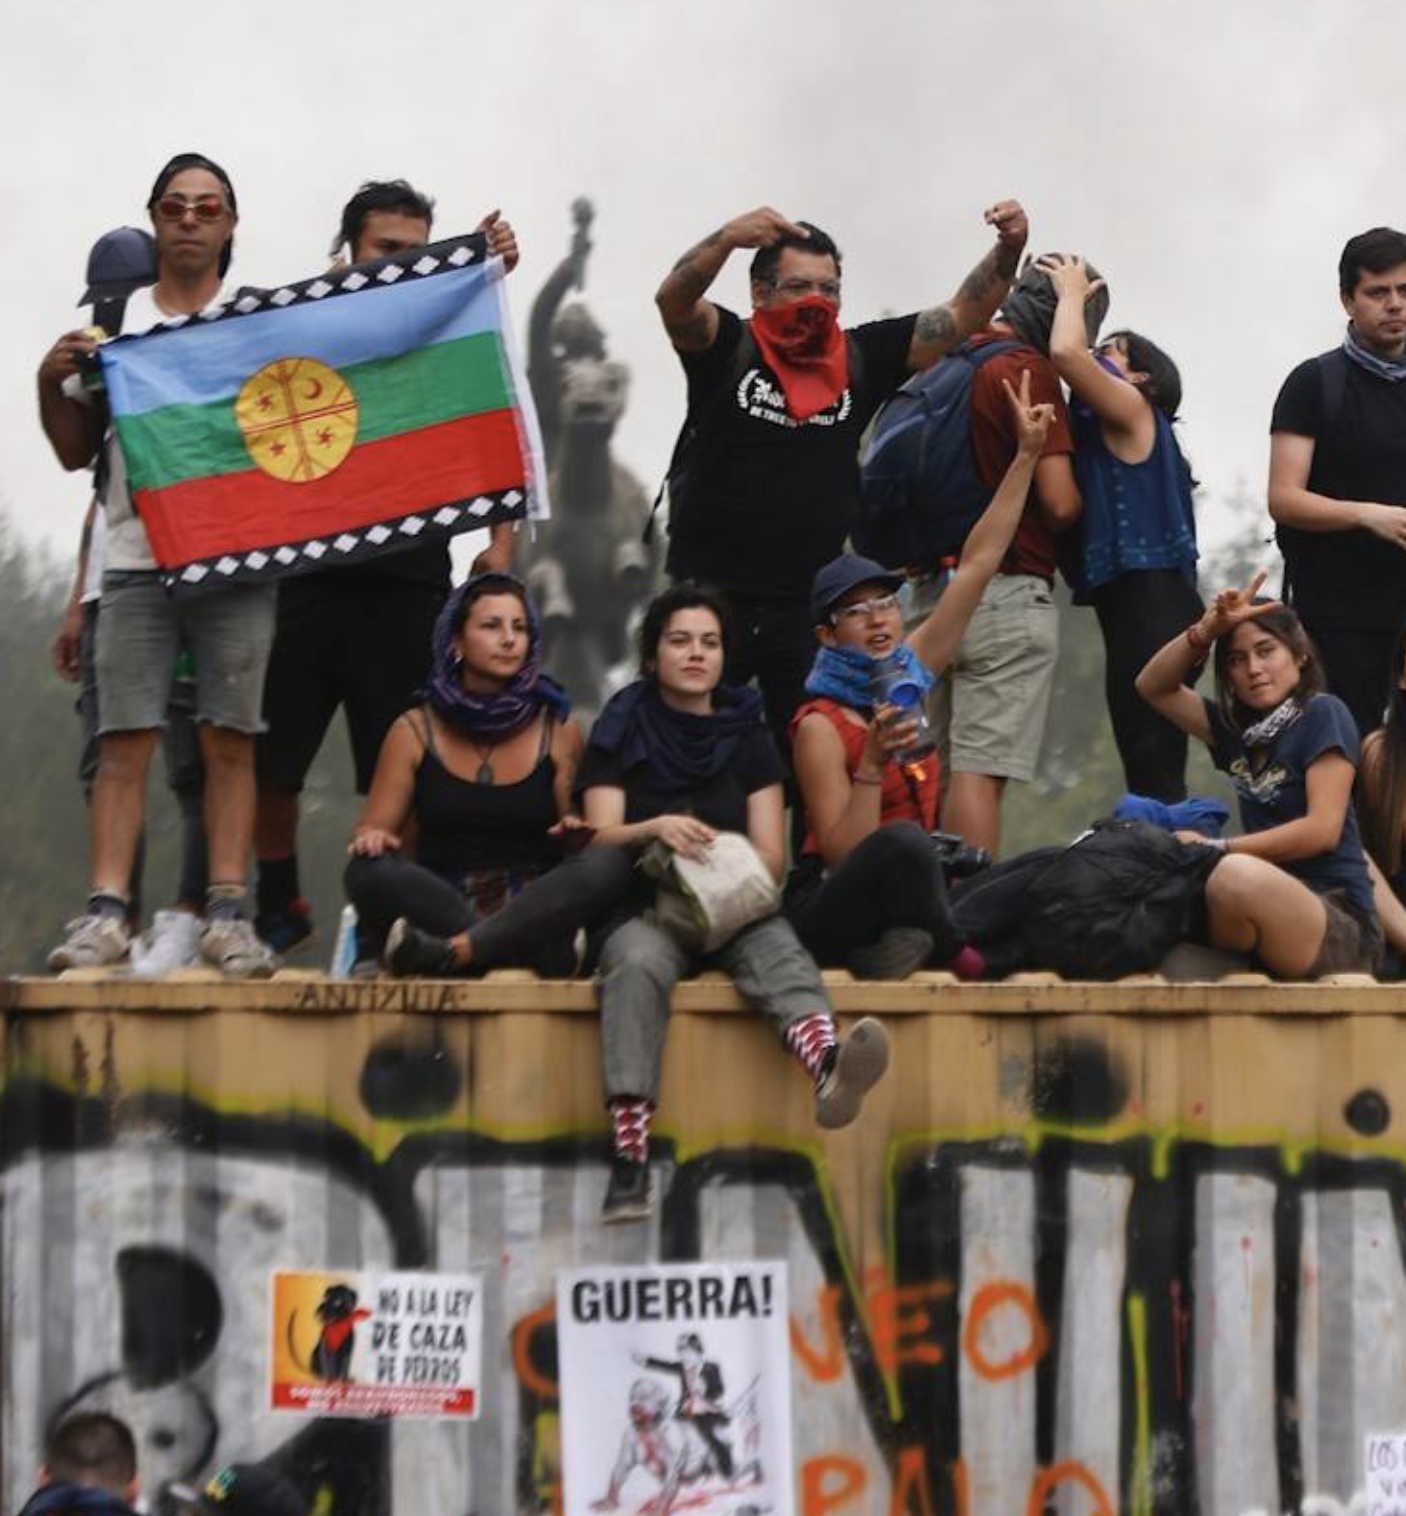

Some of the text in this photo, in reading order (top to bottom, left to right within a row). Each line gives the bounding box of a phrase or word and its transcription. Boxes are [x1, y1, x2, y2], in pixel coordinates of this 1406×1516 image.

[378, 1289, 475, 1318] NO A LA LEY
[571, 1275, 774, 1323] GUERRA!
[372, 1323, 468, 1352] DE CAZA
[377, 1356, 461, 1384] DE PERROS
[1368, 1439, 1398, 1471] LOS
